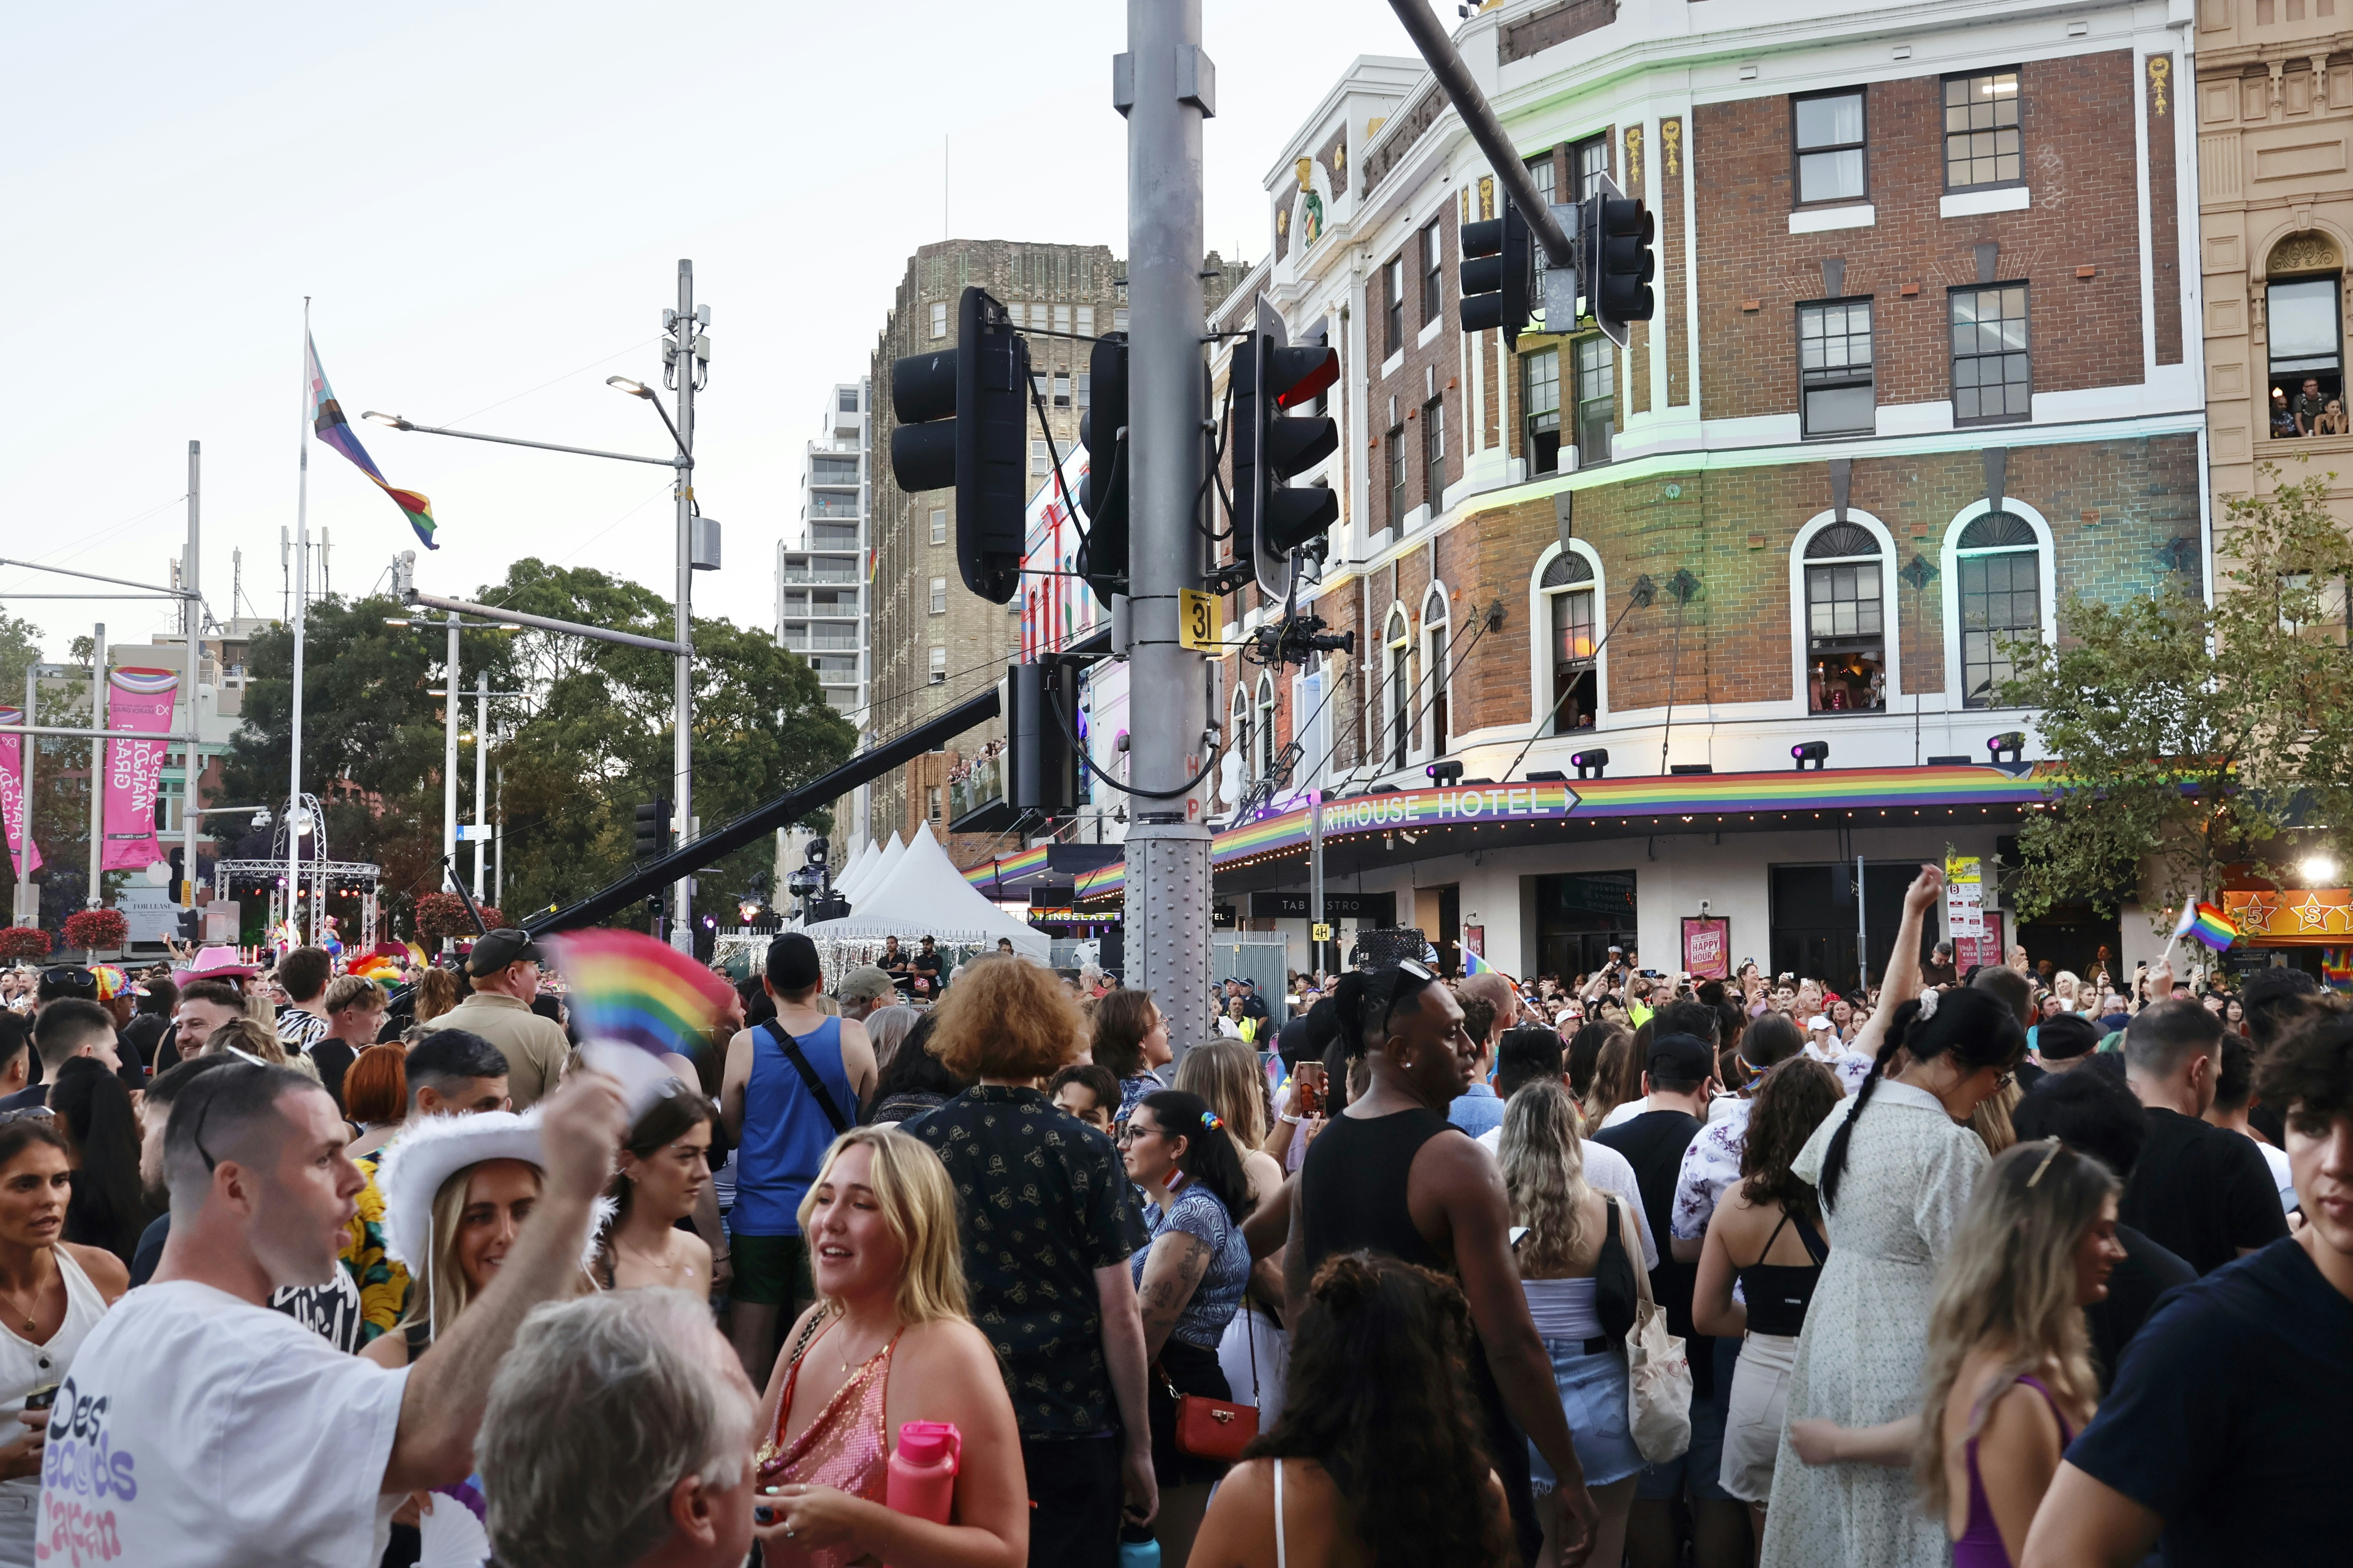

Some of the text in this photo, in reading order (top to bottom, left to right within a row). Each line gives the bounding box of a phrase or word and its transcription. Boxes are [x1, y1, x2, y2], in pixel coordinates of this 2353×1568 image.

[1192, 603, 1211, 640] 31
[1187, 756, 1199, 777] H
[1187, 798, 1199, 820] P
[1304, 788, 1549, 836] CURTHOUSE HOTEL
[1282, 900, 1359, 910] TAB STRO
[1039, 912, 1106, 921] KINSELAS
[2247, 906, 2263, 924] 5
[1315, 927, 1327, 937] 4H
[1700, 932, 1719, 940] HOTTEST
[1693, 939, 1719, 952] HAPPY
[1693, 951, 1712, 962] HOUR
